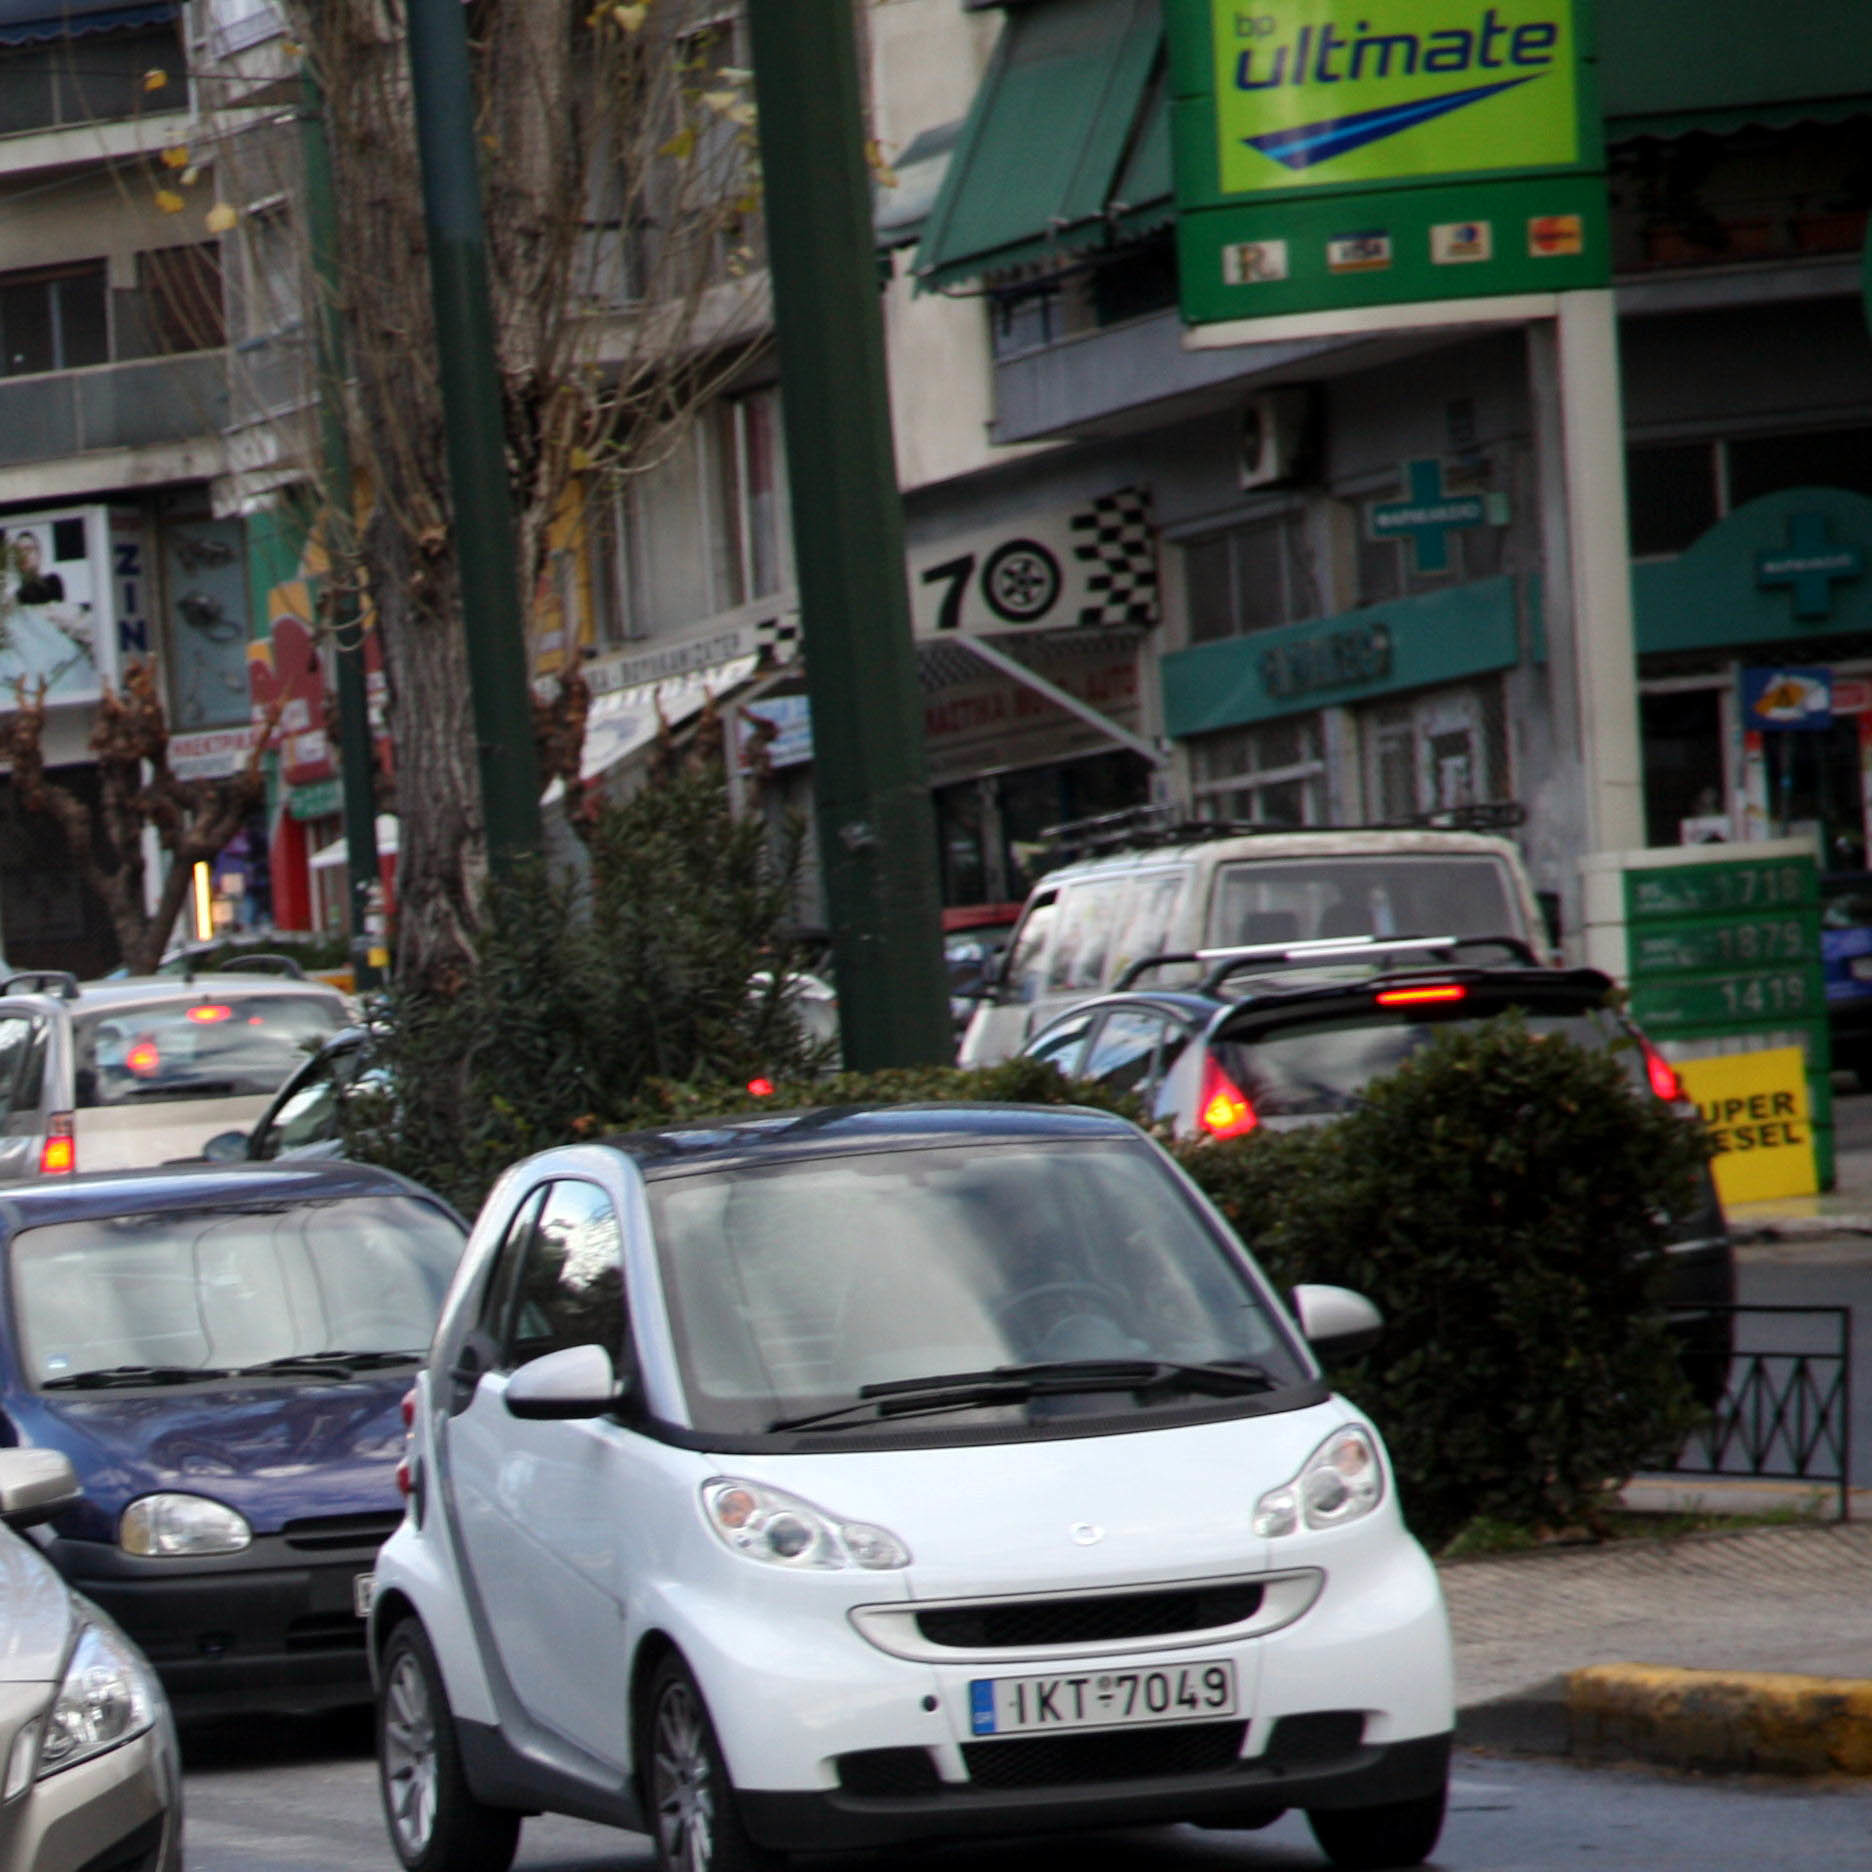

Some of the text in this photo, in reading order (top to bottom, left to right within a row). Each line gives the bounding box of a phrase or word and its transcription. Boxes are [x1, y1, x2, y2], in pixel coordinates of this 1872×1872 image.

[1235, 12, 1276, 38] bp
[1235, 9, 1559, 90] ultimate
[1697, 1091, 1795, 1126] UPER
[1712, 1121, 1802, 1152] ESEL
